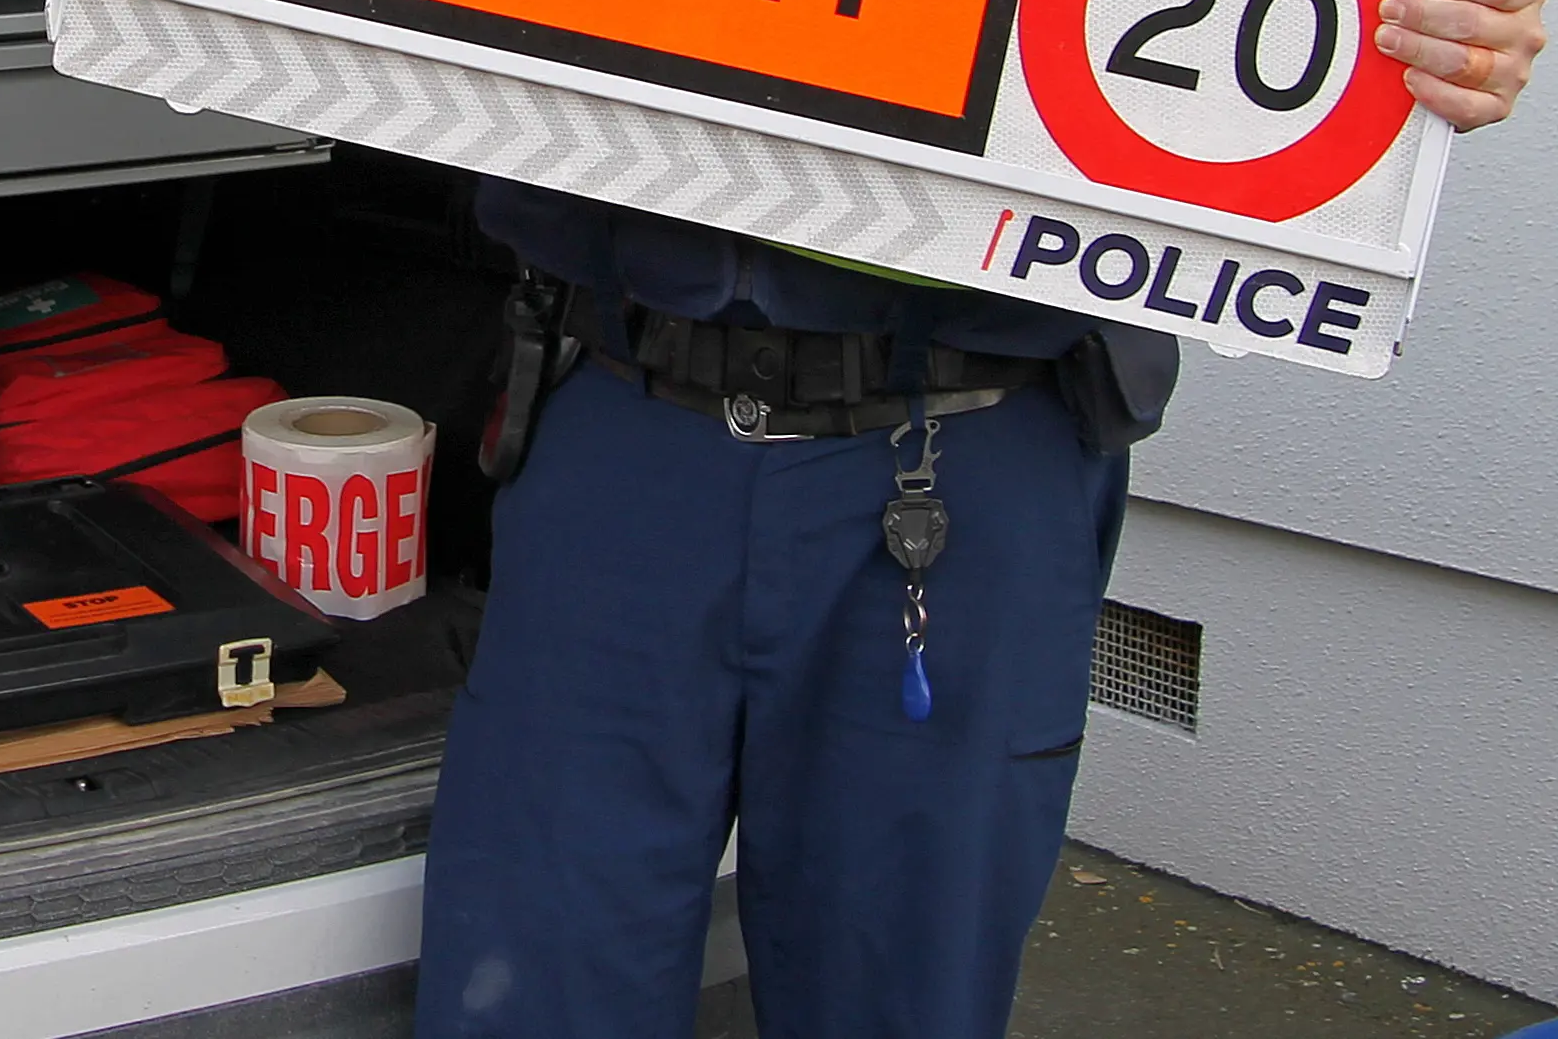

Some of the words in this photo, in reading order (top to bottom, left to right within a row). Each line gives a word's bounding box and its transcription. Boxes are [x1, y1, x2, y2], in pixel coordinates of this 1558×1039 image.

[1010, 215, 1370, 354] POLICE
[242, 454, 431, 598] ERGE
[62, 595, 119, 609] STOP
